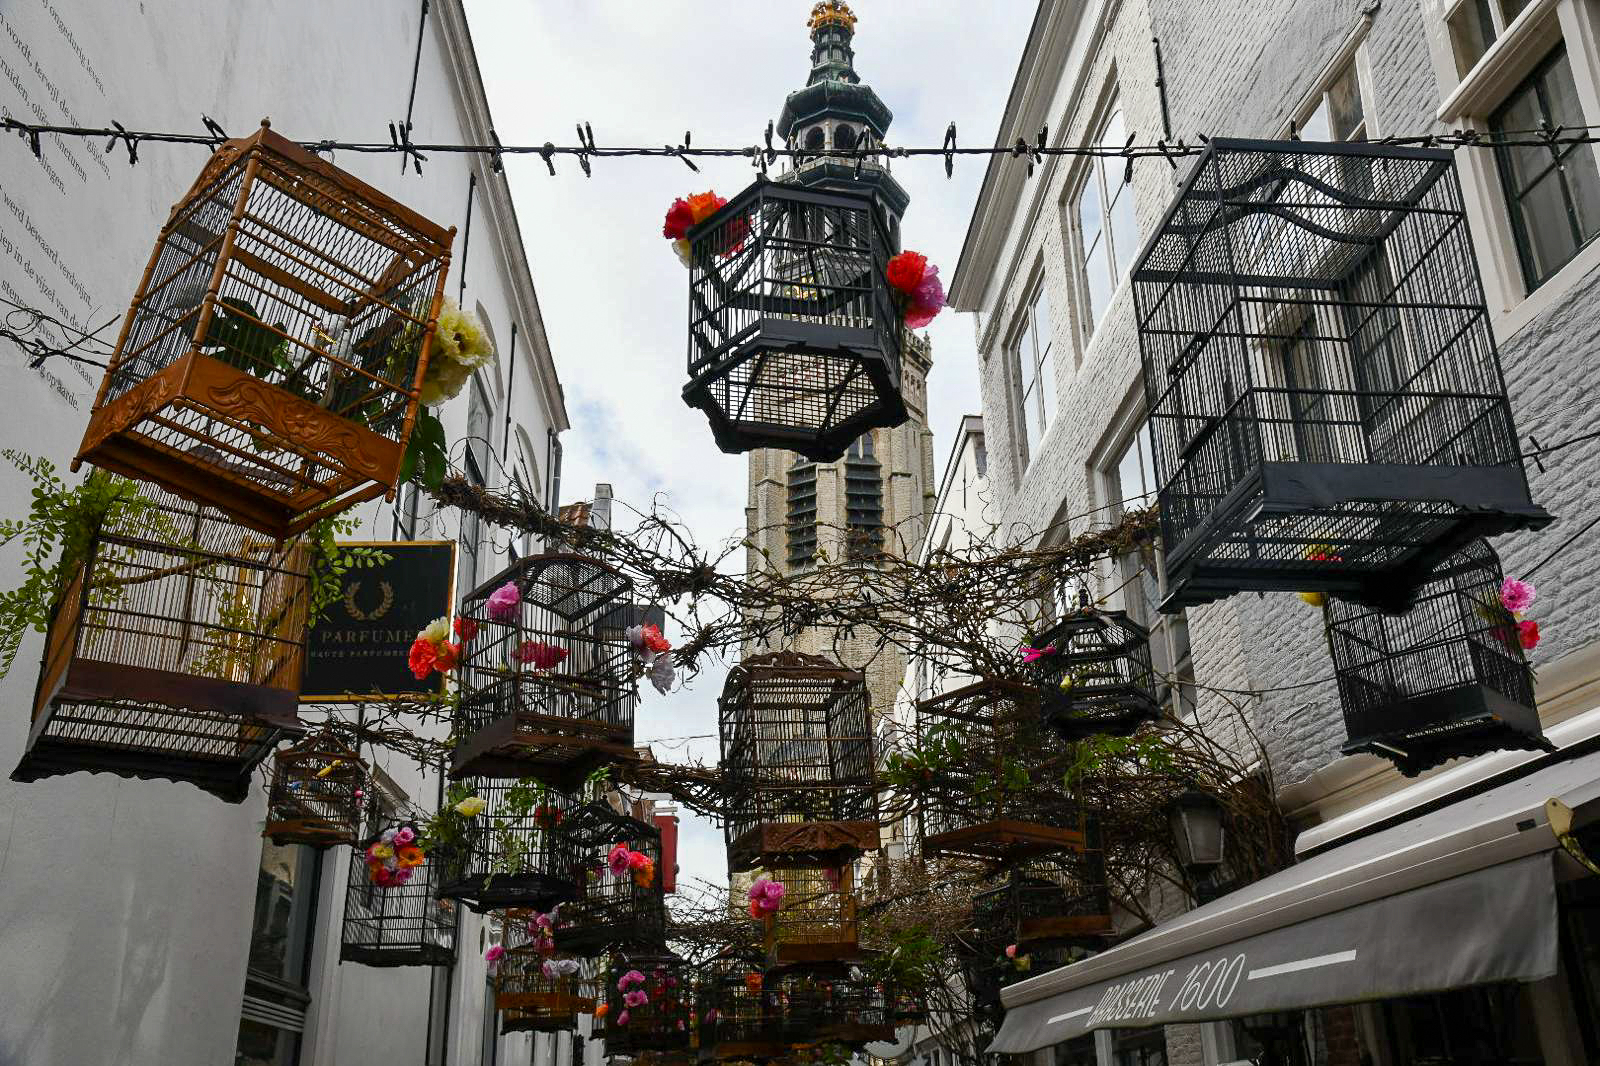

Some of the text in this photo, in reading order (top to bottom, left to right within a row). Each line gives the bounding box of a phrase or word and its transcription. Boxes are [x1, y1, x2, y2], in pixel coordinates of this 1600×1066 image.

[0, 56, 30, 106] ruiden,
[6, 22, 33, 67] wordt,
[34, 61, 59, 103] terwijl
[59, 99, 70, 118] de
[4, 191, 25, 224] werd
[25, 215, 58, 264] bewaard
[0, 228, 13, 254] iep
[14, 246, 23, 265] in
[24, 260, 34, 279] de
[56, 298, 69, 320] van
[70, 313, 79, 330] de
[1085, 953, 1246, 1028] BRASSERIE 1600
